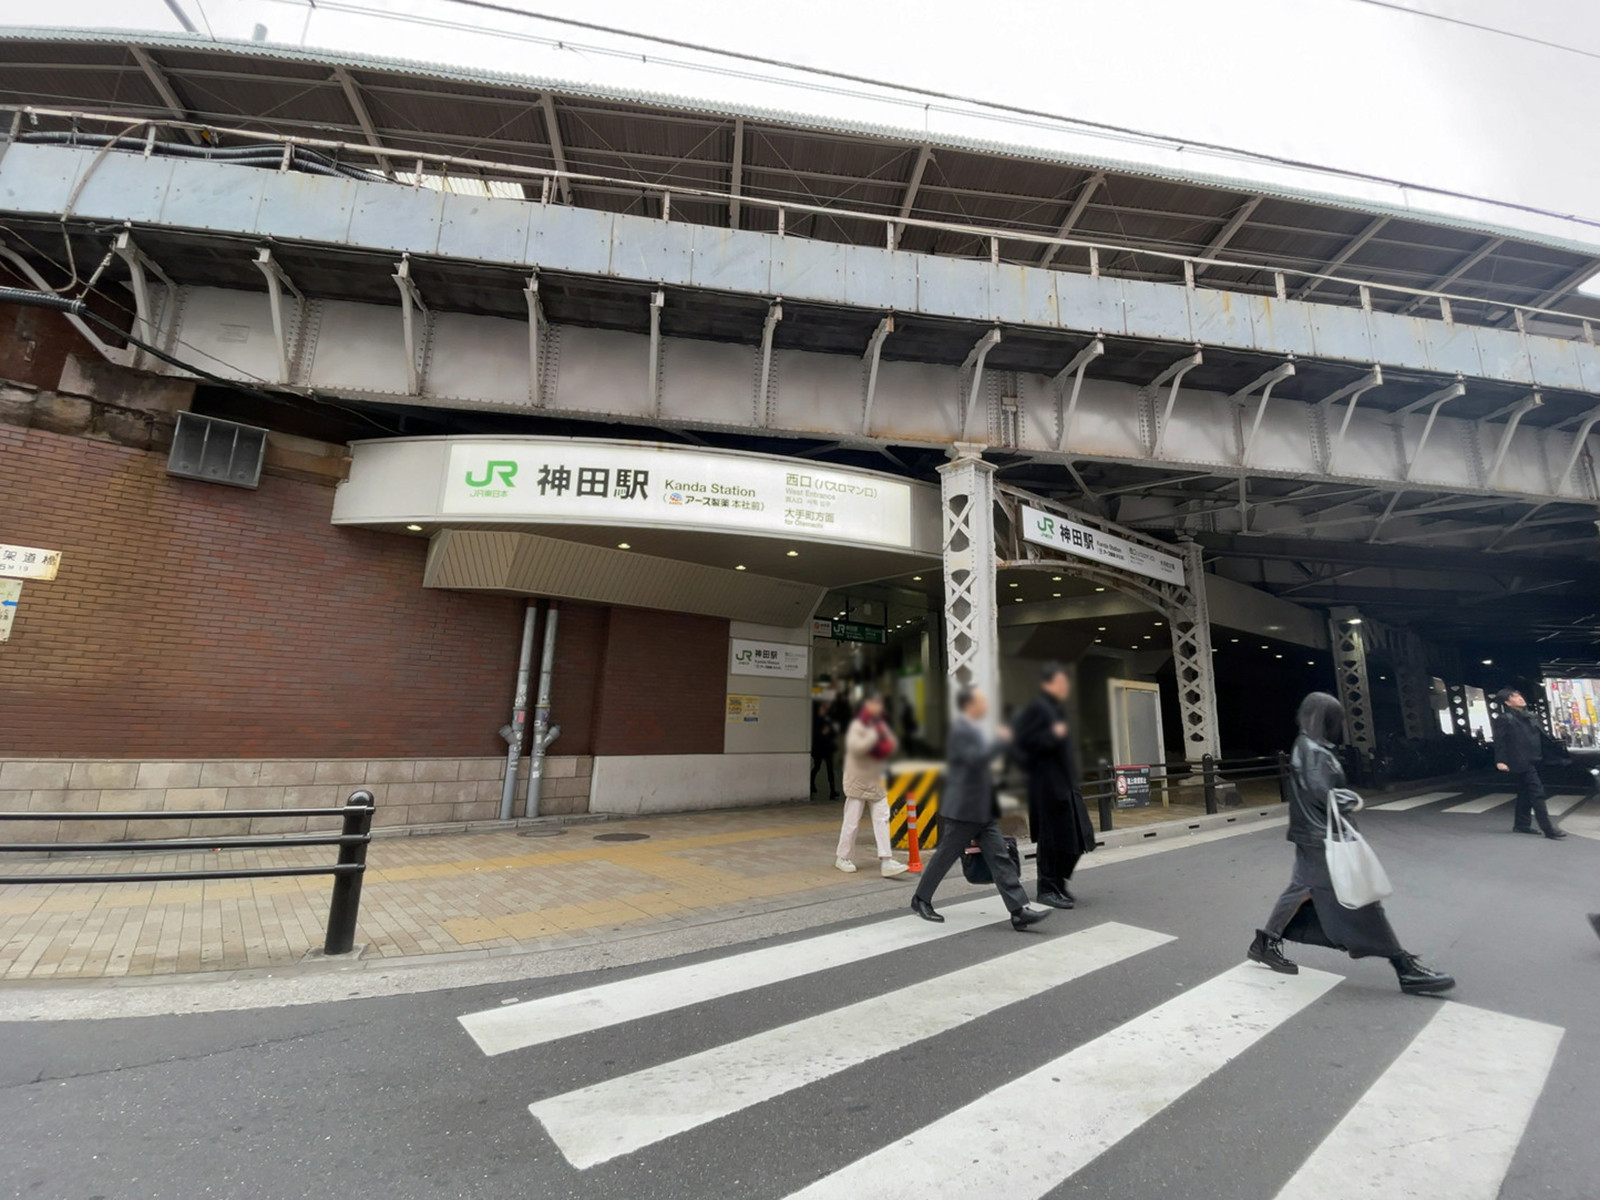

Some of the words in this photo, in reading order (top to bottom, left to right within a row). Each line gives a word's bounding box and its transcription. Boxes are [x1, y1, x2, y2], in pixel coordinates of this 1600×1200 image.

[465, 460, 518, 488] JR
[536, 464, 650, 501] 神田駅
[664, 479, 707, 493] Kanda
[710, 483, 756, 497] Station
[469, 489, 509, 498] JR東日本
[785, 487, 804, 496] West
[1036, 516, 1055, 535] JR
[1059, 523, 1095, 551] 神田駅
[833, 623, 845, 634] JR
[735, 649, 753, 662] JR
[754, 649, 778, 660] 神田駅
